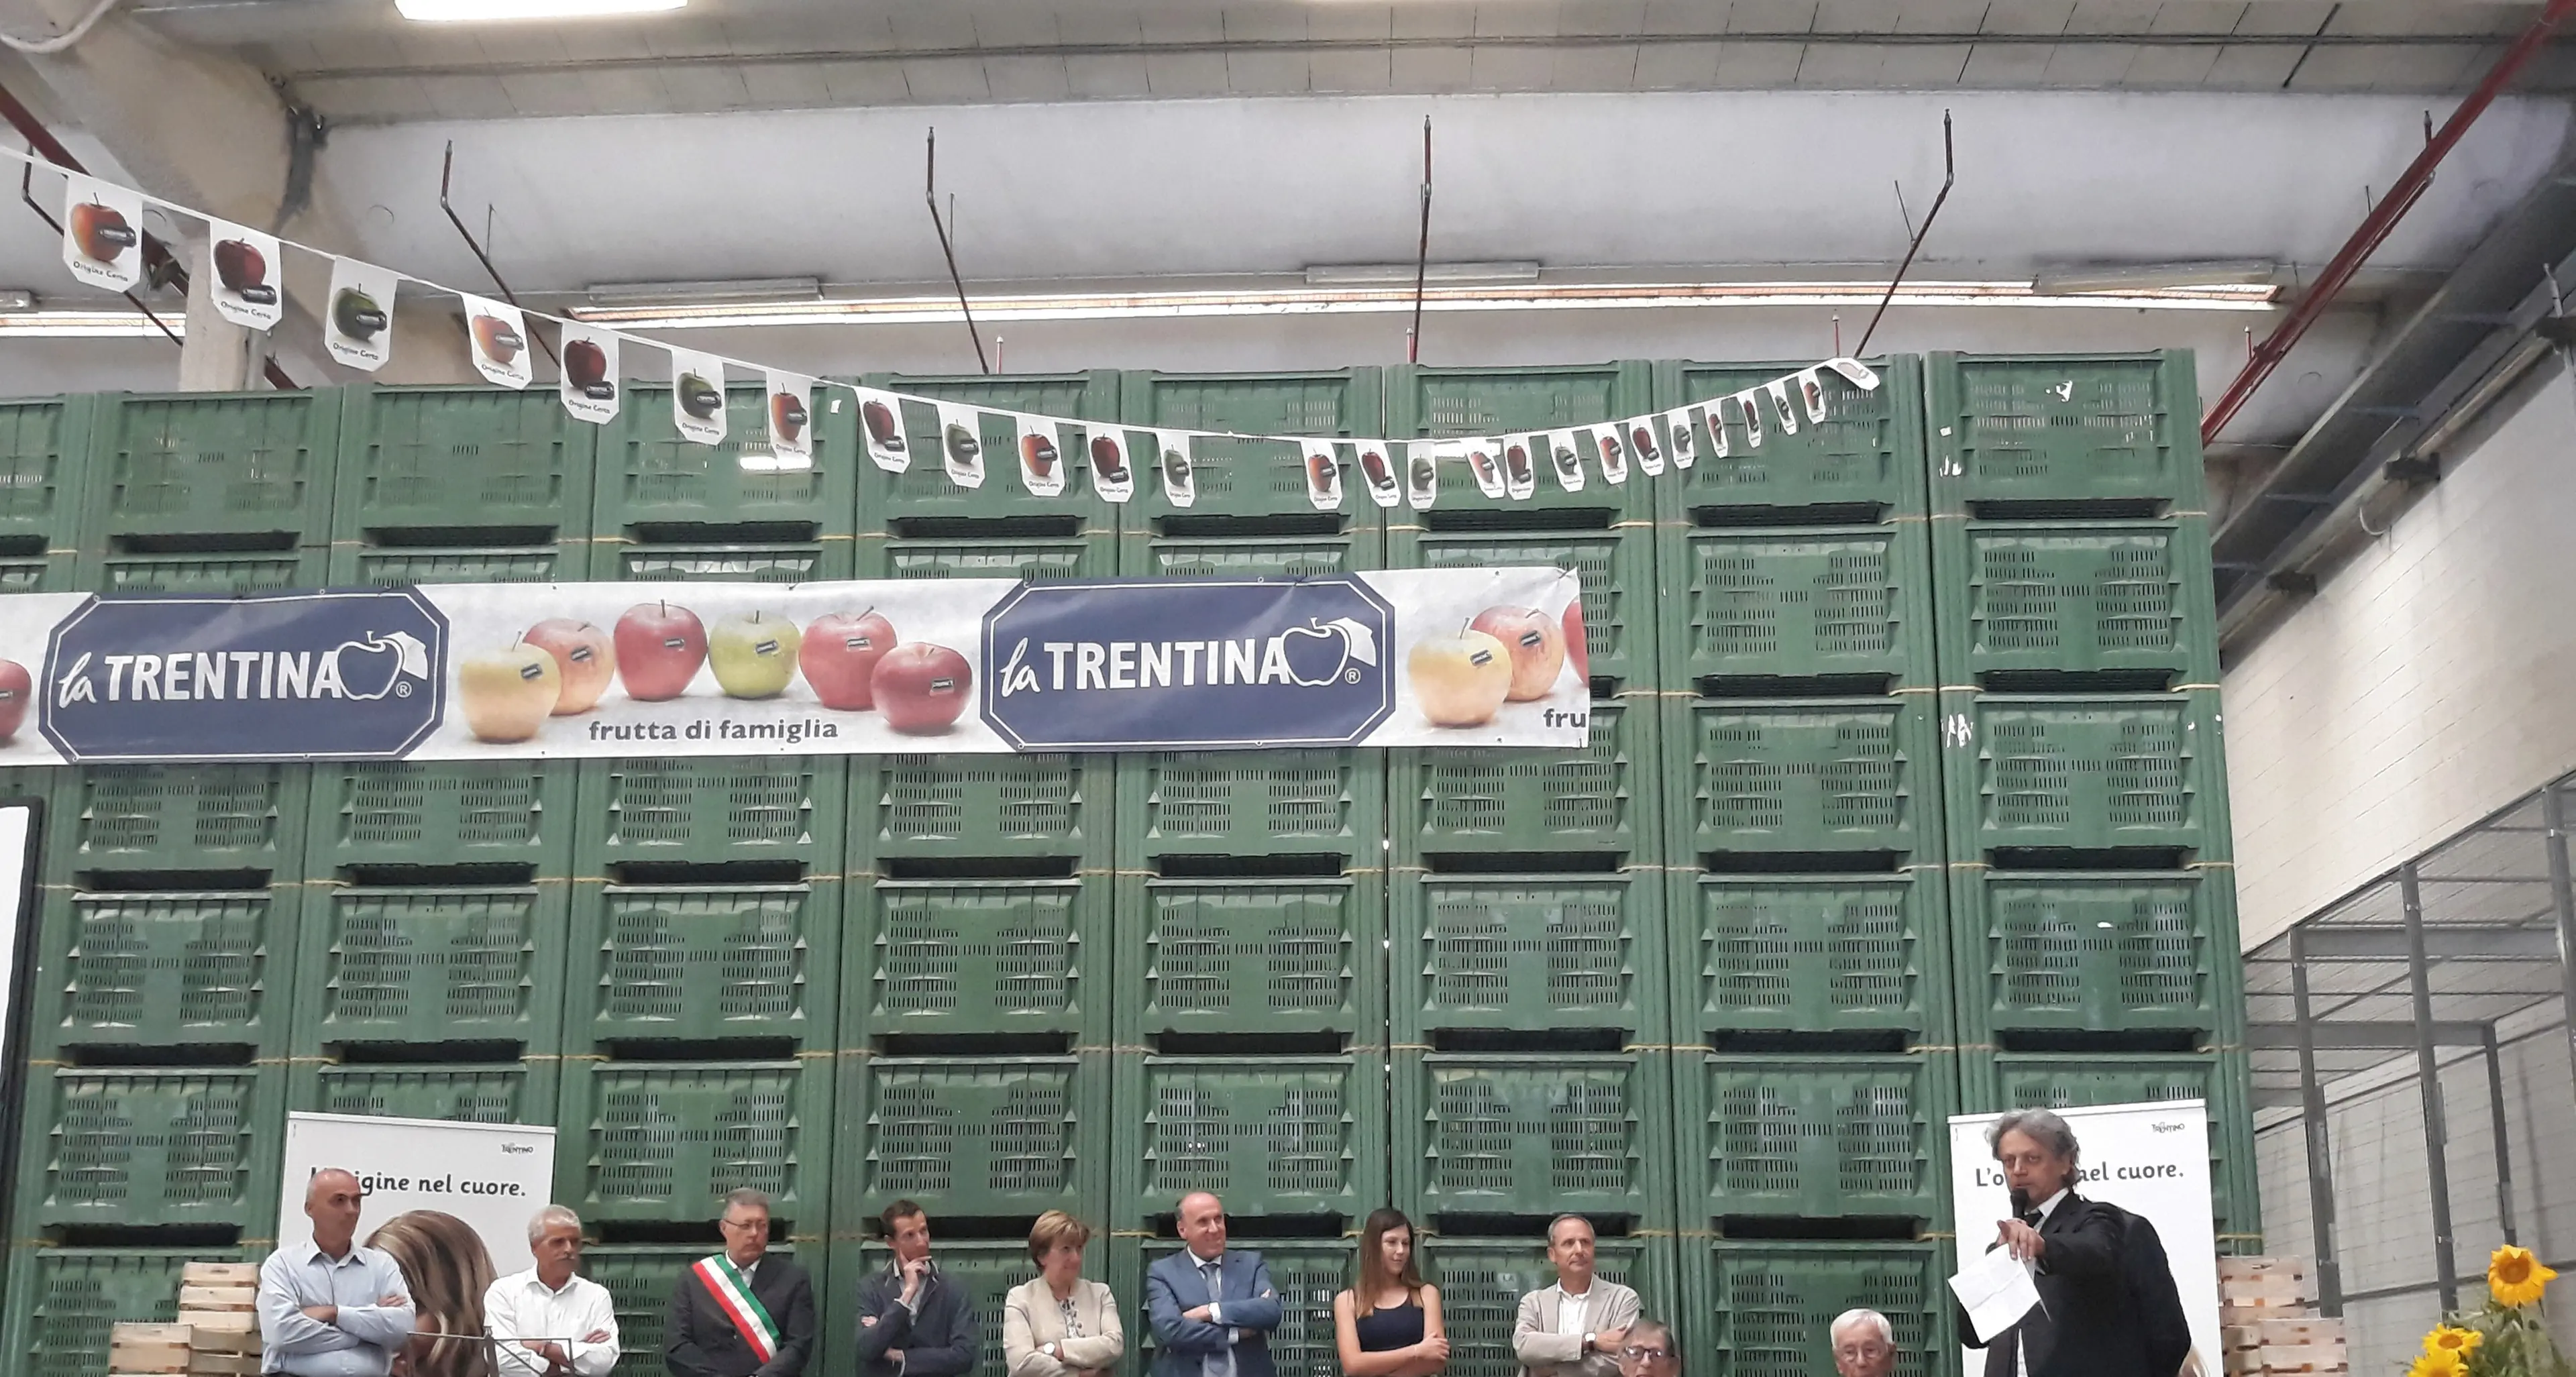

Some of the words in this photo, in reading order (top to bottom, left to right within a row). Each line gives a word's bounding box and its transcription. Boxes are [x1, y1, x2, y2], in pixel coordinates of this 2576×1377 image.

[58, 651, 97, 708] la
[103, 650, 342, 702] TRENTINA
[1000, 637, 1041, 698] la
[1043, 637, 1292, 691] TRENTINA
[588, 720, 678, 741] frutta
[686, 720, 711, 740] di
[720, 719, 839, 744] famiglia
[2117, 1164, 2184, 1180] cuore.
[418, 1173, 452, 1193] nel
[460, 1180, 526, 1197] cuore.
